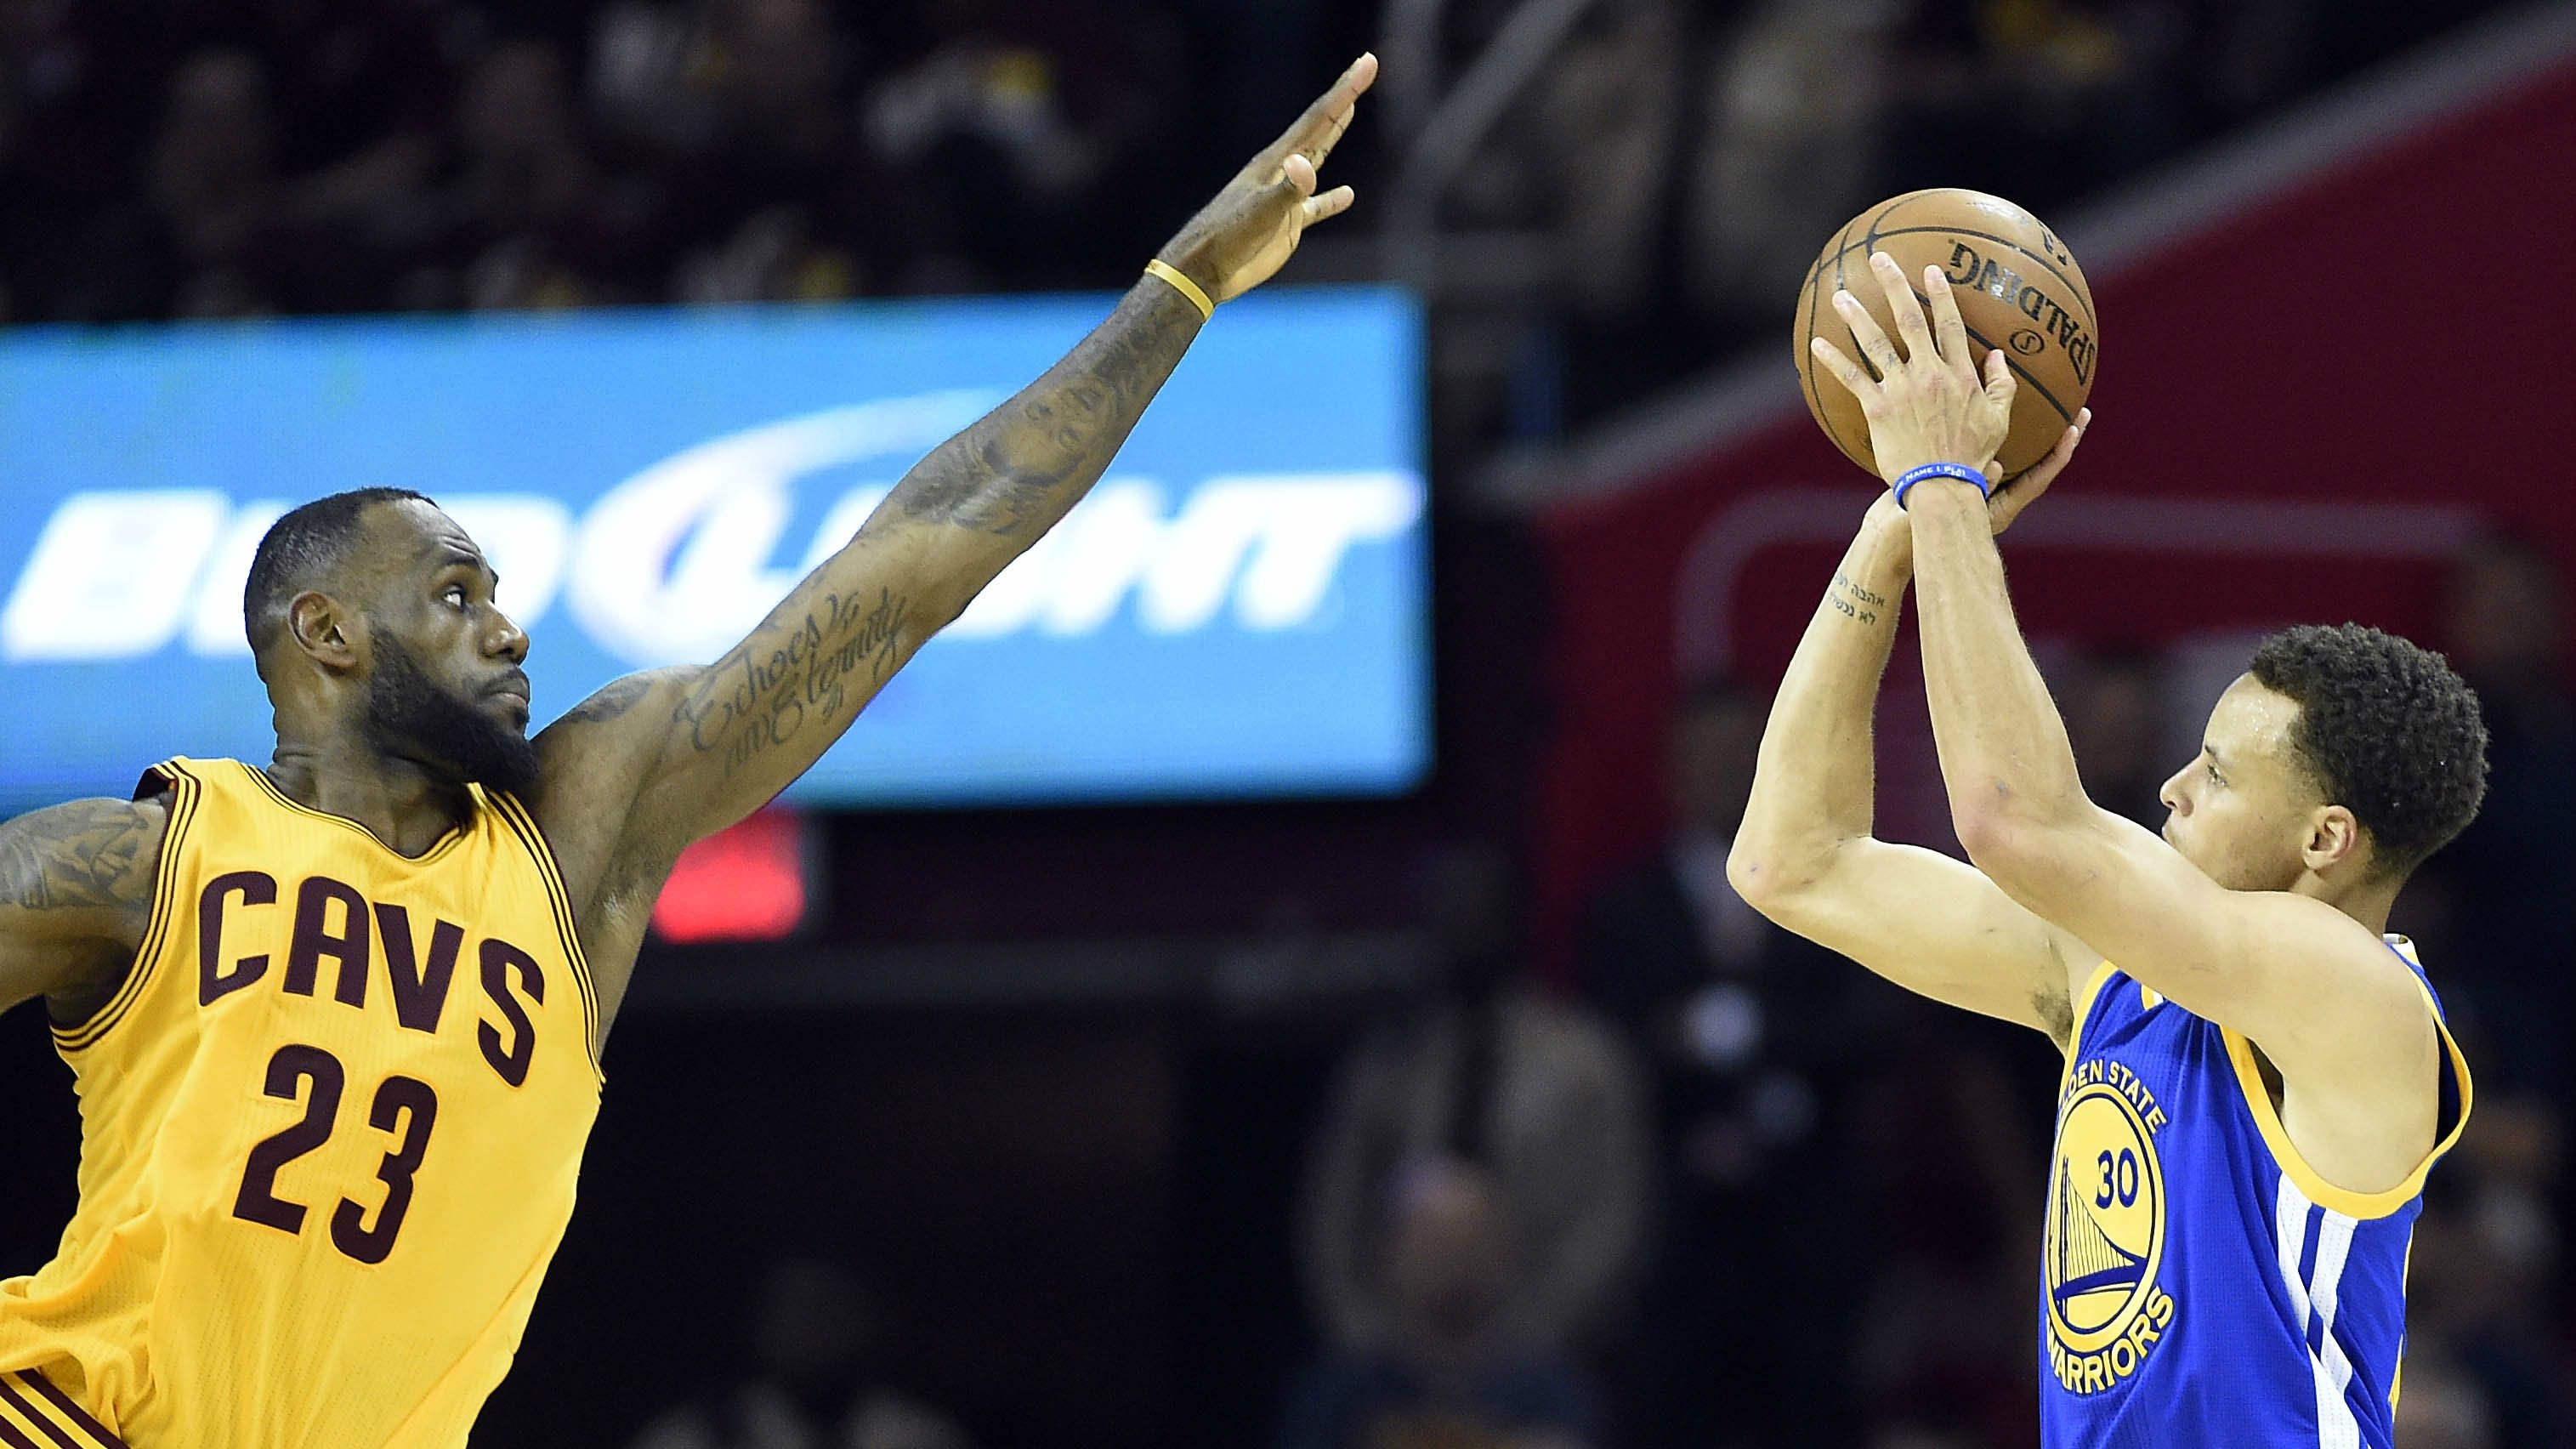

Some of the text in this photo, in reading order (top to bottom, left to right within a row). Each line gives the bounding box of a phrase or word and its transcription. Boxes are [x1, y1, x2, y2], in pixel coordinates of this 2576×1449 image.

[1944, 242, 2096, 386] SPALDING
[1905, 468, 1933, 482] NAME
[629, 459, 1424, 648] LHT
[199, 871, 545, 1088] CAVS
[232, 1043, 439, 1265] 23
[2061, 1059, 2167, 1135] DEN STATE
[2095, 1147, 2139, 1209] 30
[2045, 1285, 2174, 1395] WARRIORS
